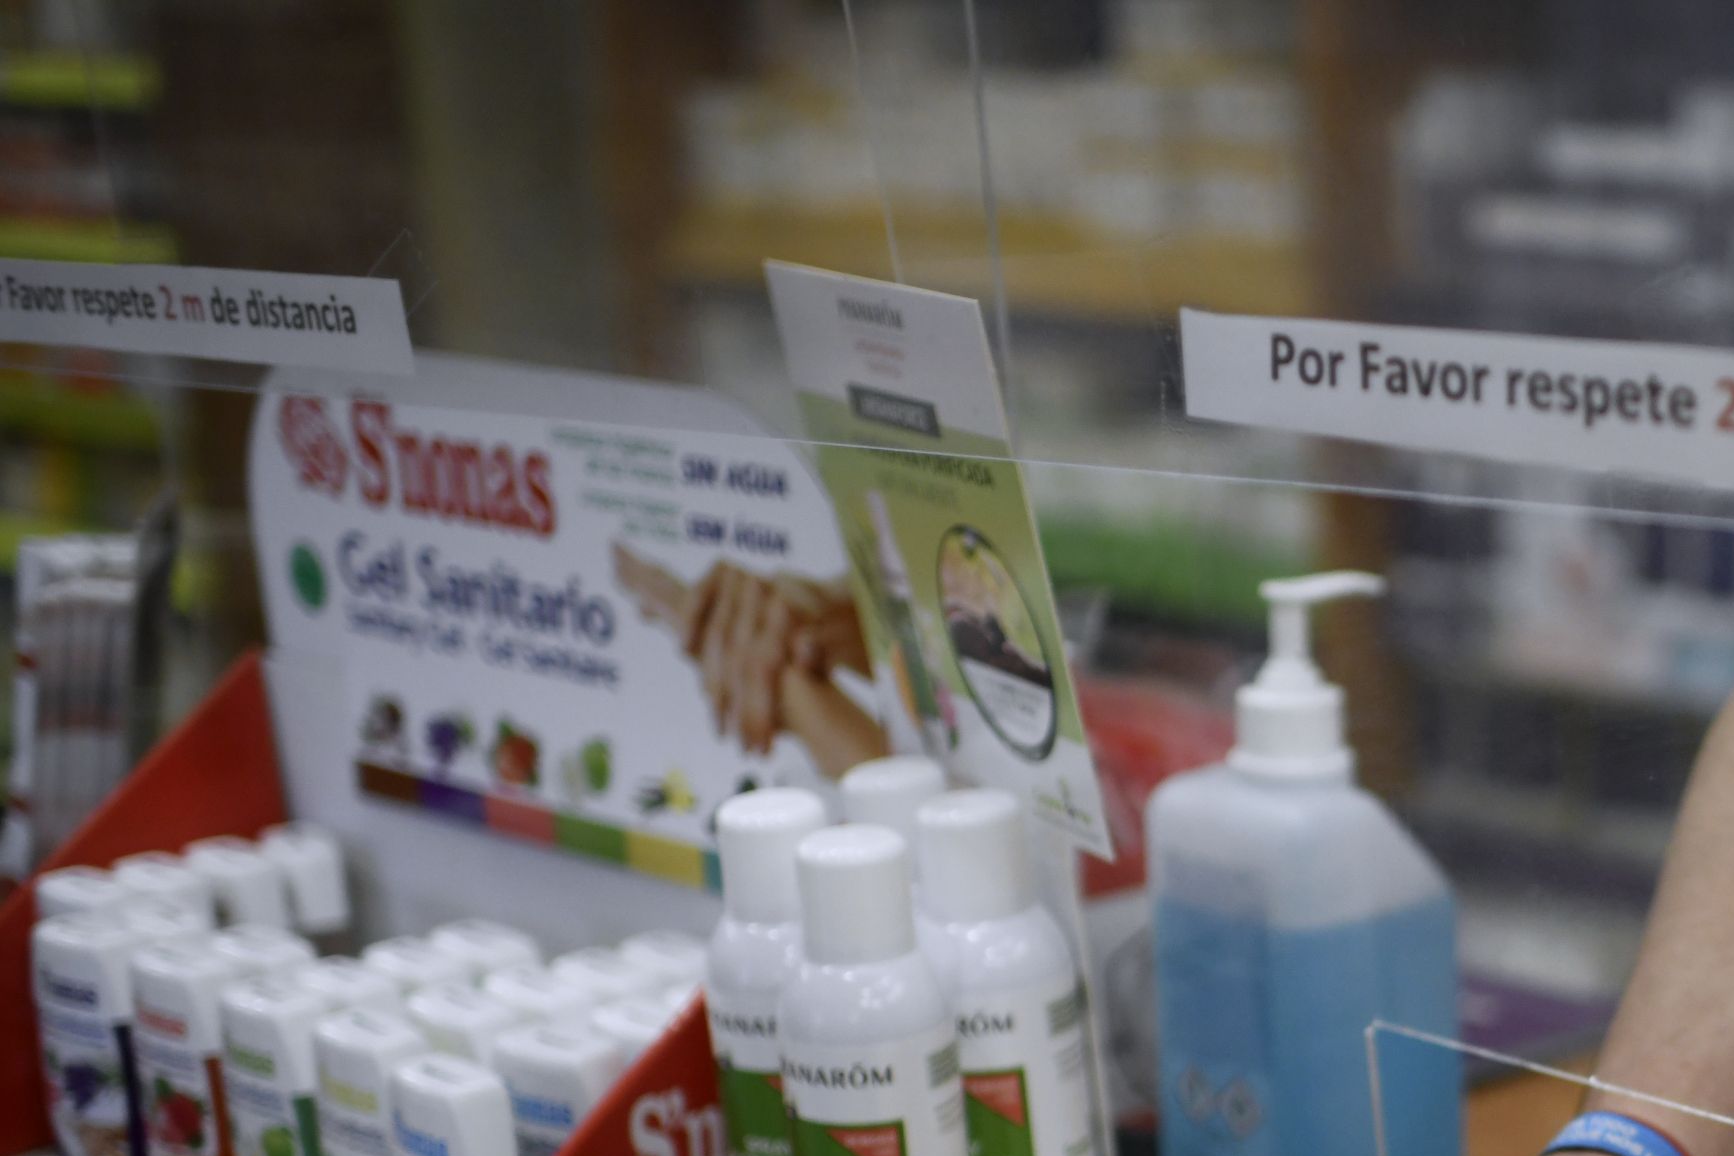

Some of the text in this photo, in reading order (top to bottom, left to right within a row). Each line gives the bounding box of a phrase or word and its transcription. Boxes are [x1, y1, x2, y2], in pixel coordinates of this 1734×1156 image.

[5, 275, 358, 334] Favor respete 2 m de distancia
[1269, 333, 1345, 389] Por
[1358, 341, 1490, 403] Favor
[1505, 365, 1698, 434] respete
